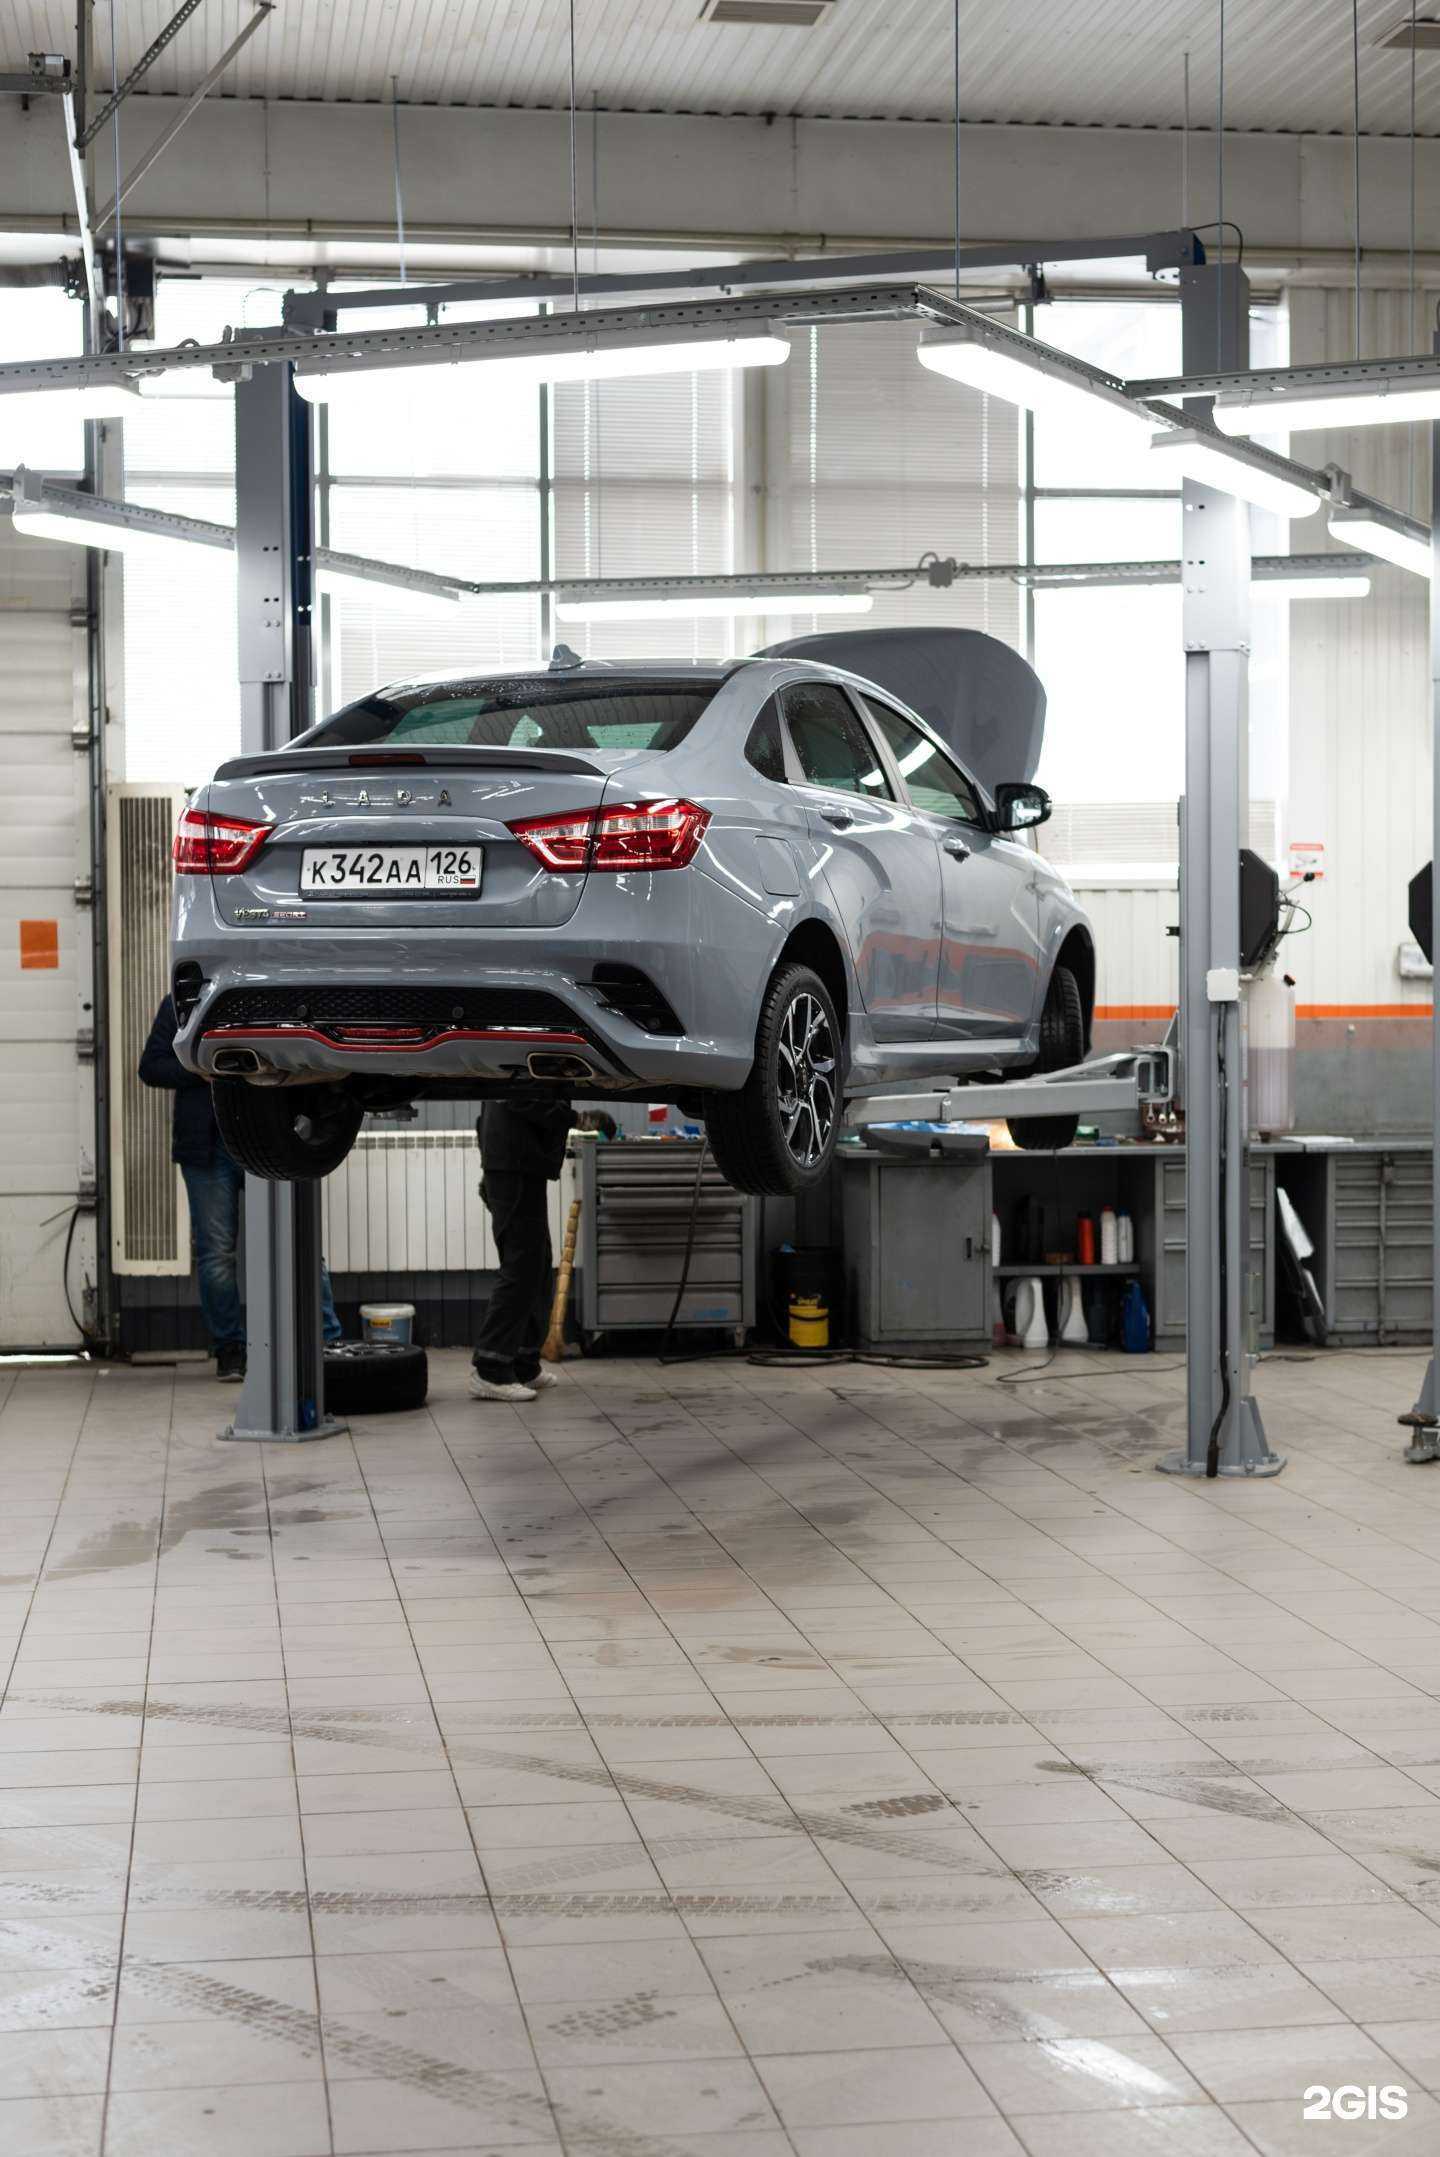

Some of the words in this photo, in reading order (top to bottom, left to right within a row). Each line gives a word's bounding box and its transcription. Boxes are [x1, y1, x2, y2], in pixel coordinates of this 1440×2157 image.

[321, 789, 453, 808] LADA
[430, 851, 472, 875] 126
[437, 875, 460, 884] RUS
